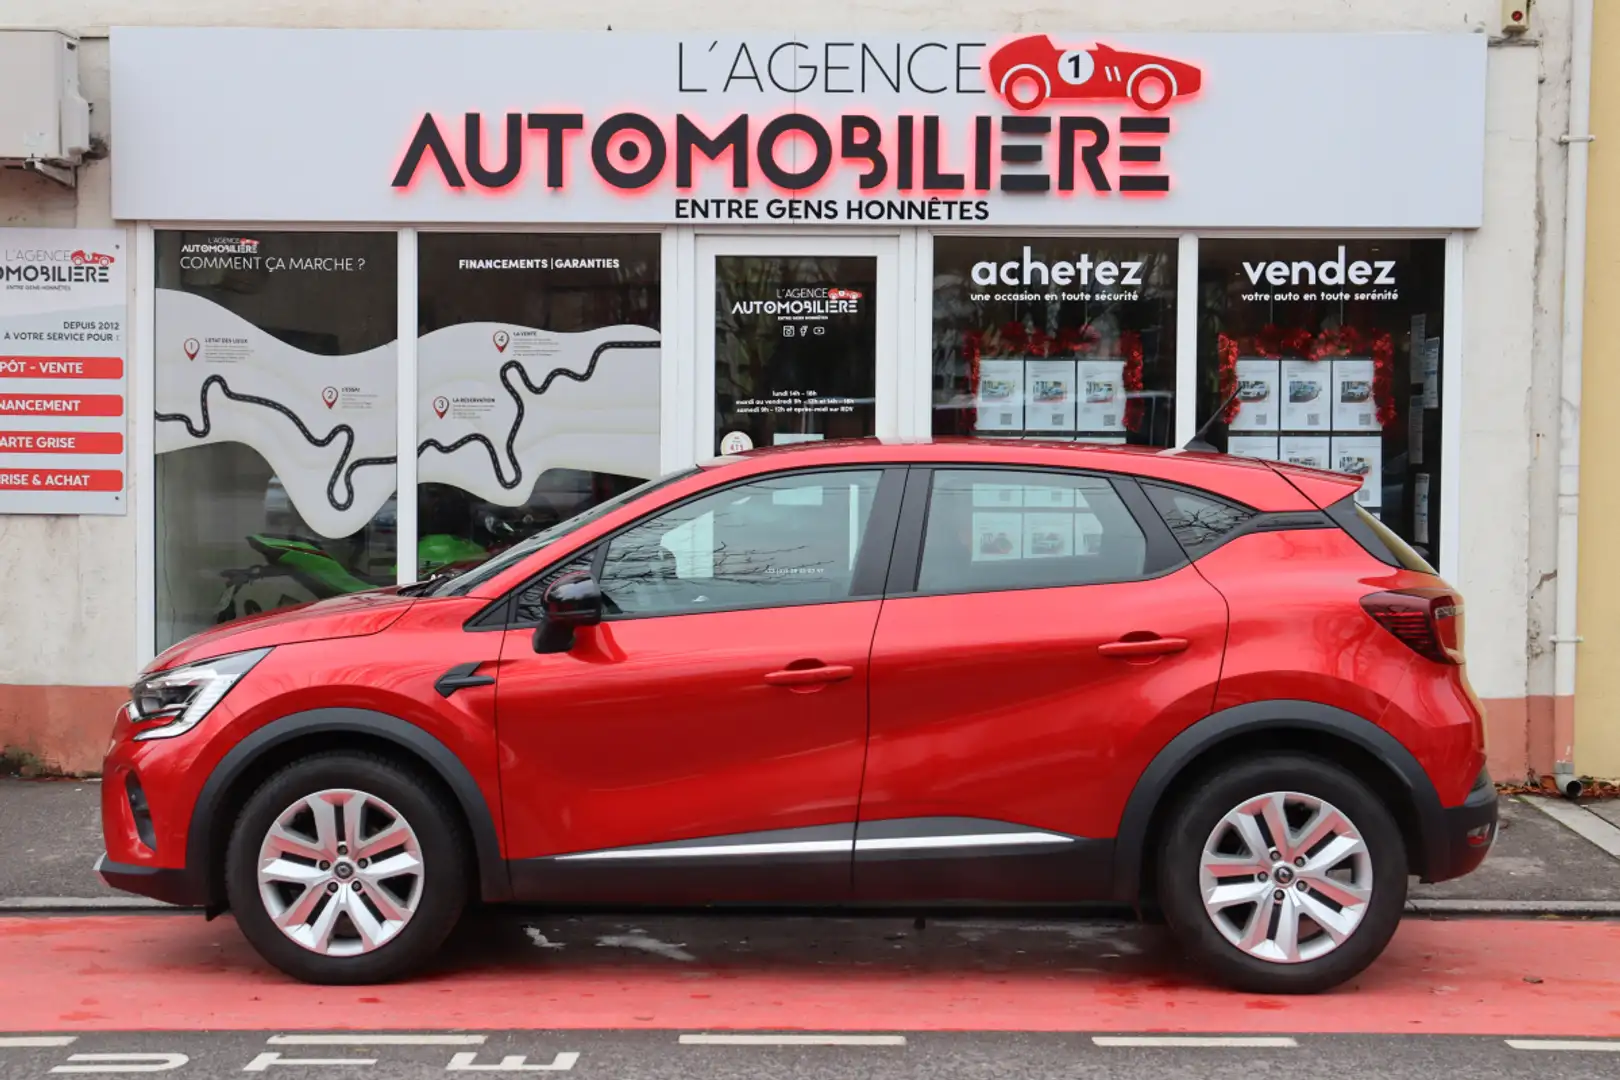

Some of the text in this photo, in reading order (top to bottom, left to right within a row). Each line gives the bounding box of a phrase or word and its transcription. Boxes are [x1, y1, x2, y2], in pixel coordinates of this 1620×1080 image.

[679, 40, 987, 93] L'AGENCE
[1067, 54, 1080, 78] 1
[391, 112, 1170, 191] AUTOMOBILIERE
[675, 197, 990, 220] ENTRE GENS HONNÊTES
[180, 256, 366, 272] COMMENT ÇA MARCHE ?
[459, 259, 548, 269] FINANCEMENTS
[971, 246, 1142, 286] achetez
[1242, 246, 1396, 286] vendez
[0, 265, 109, 282] MOBILIERE
[970, 292, 990, 300] une
[994, 290, 1041, 300] occasion
[1062, 292, 1091, 300] toute
[1095, 290, 1138, 300] sécurité
[1242, 292, 1270, 300] votre
[1274, 292, 1300, 300] auto
[1304, 292, 1317, 300] en
[1320, 291, 1350, 300] toute
[732, 300, 858, 314] AUTOMOBILIERE
[64, 322, 120, 330] DEPUIS 2012
[14, 332, 44, 340] VOTRE
[47, 332, 84, 341] SERVICE
[86, 333, 113, 341] POUR
[0, 359, 27, 373] PÔT
[39, 362, 84, 374] VENTE
[328, 390, 333, 399] 2
[0, 436, 76, 448] ARTE GRISE
[32, 474, 42, 486] &
[45, 475, 90, 486] ACHAT
